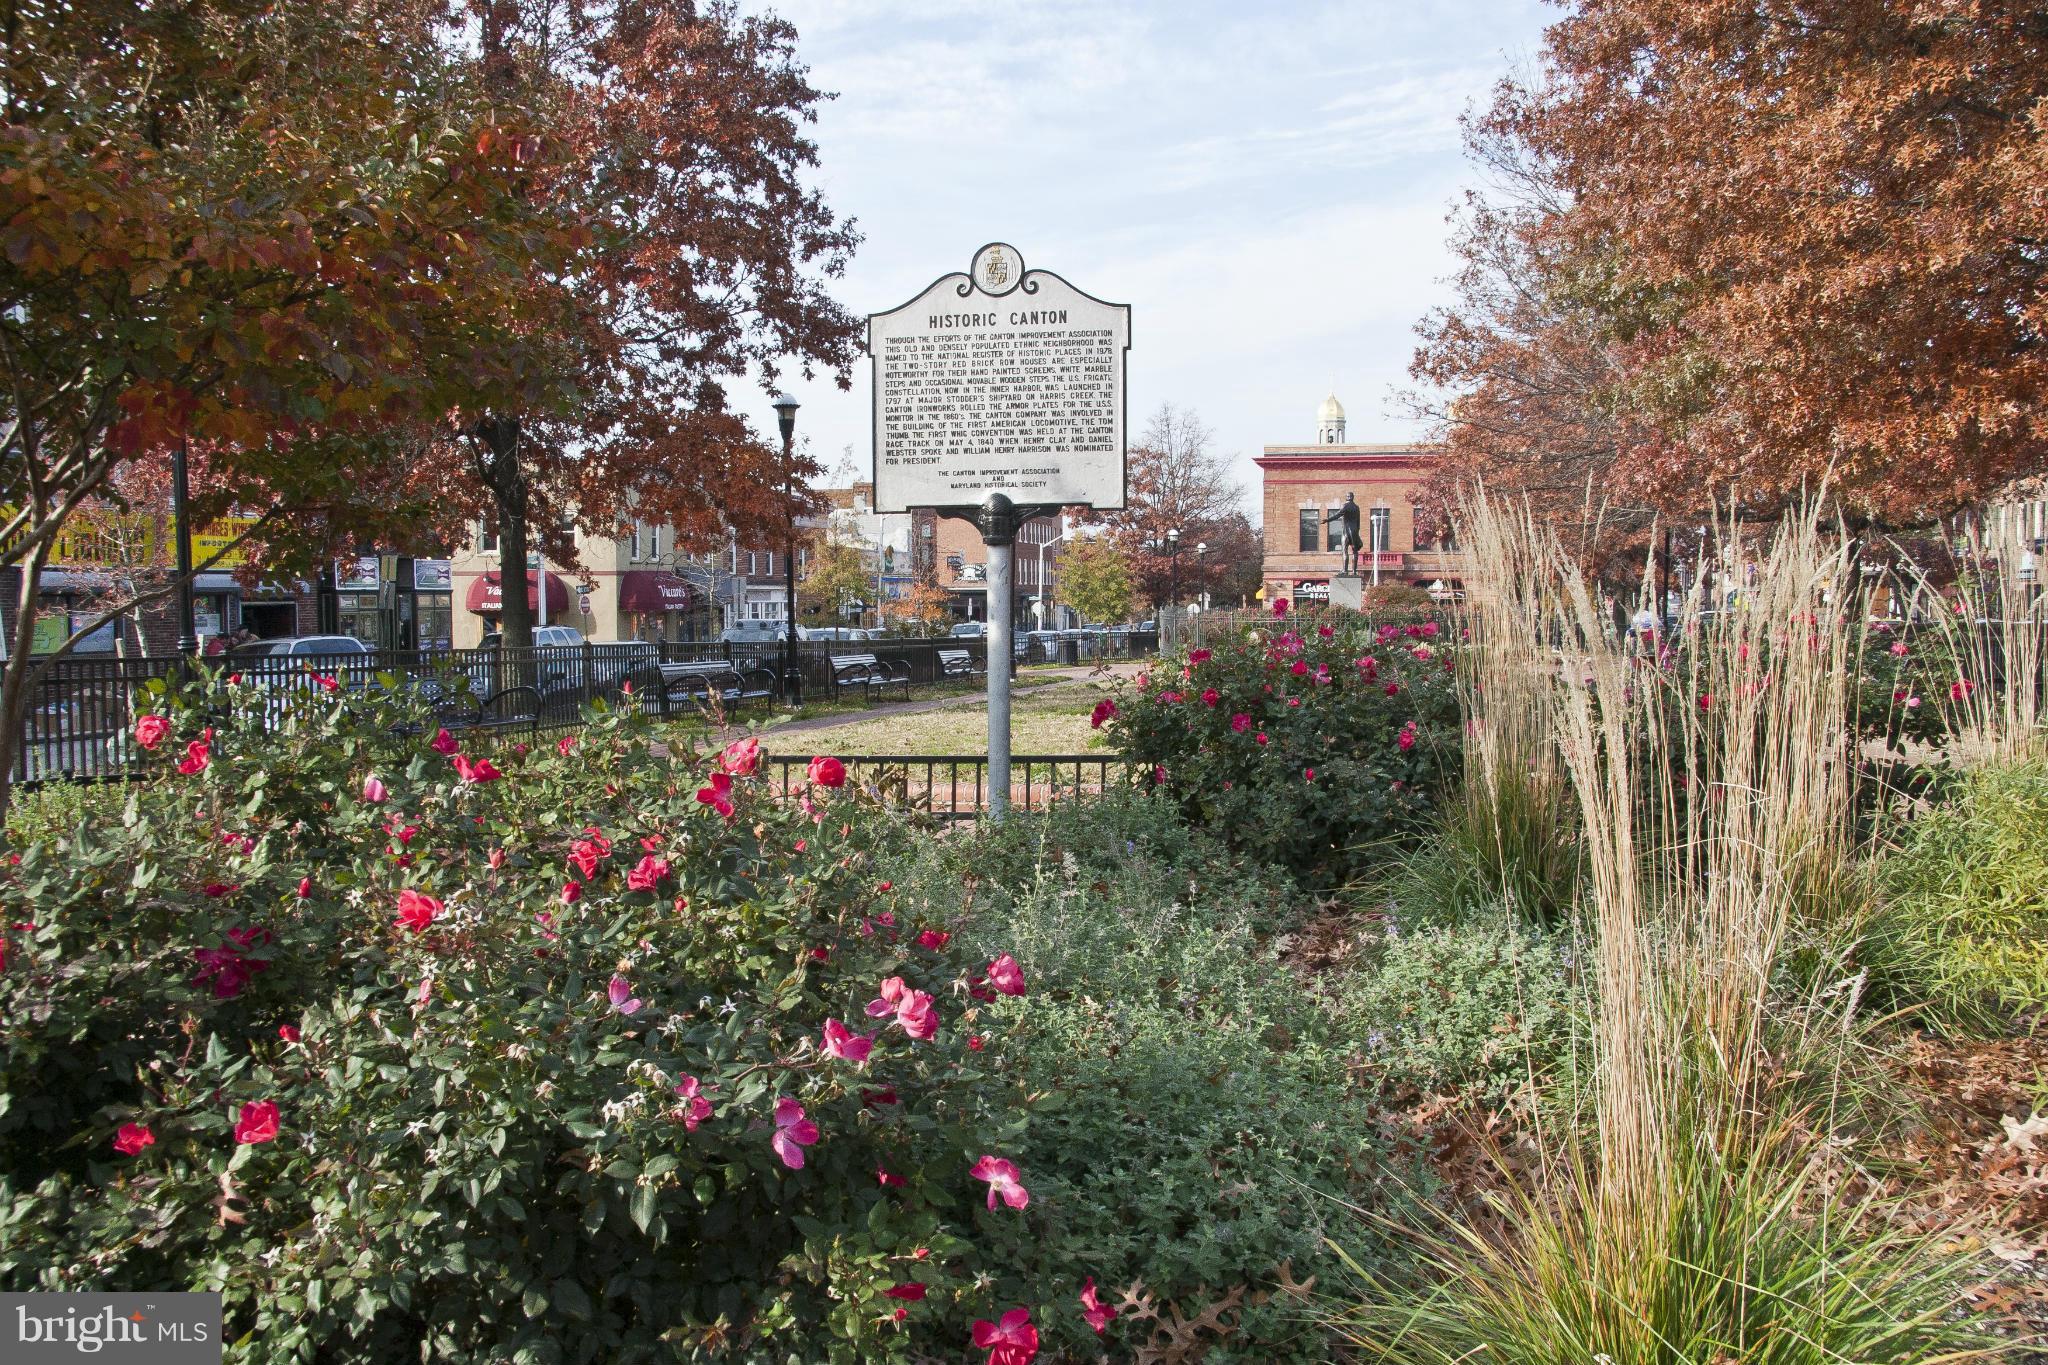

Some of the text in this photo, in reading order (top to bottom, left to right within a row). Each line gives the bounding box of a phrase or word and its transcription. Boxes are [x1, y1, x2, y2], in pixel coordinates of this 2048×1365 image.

[929, 311, 1067, 328] HISTORIC CANTON
[1018, 331, 1065, 340] IMPROVEMENT
[1068, 329, 1113, 338] ASSOCIATION
[938, 343, 967, 351] DENSELY
[971, 342, 1010, 350] POPULATED
[1043, 339, 1094, 348] NEIGHBORHOOD
[937, 352, 968, 360] NATIONAL
[972, 351, 1004, 359] REGISTER
[1018, 349, 1051, 357] HISTORIC
[1070, 356, 1112, 364] ESPECIALLY
[885, 370, 928, 378] NOTEWORTHY
[925, 378, 963, 386] OCCASIONAL
[989, 394, 1022, 402] SHIPYARD
[916, 404, 956, 412] IRONWORKS
